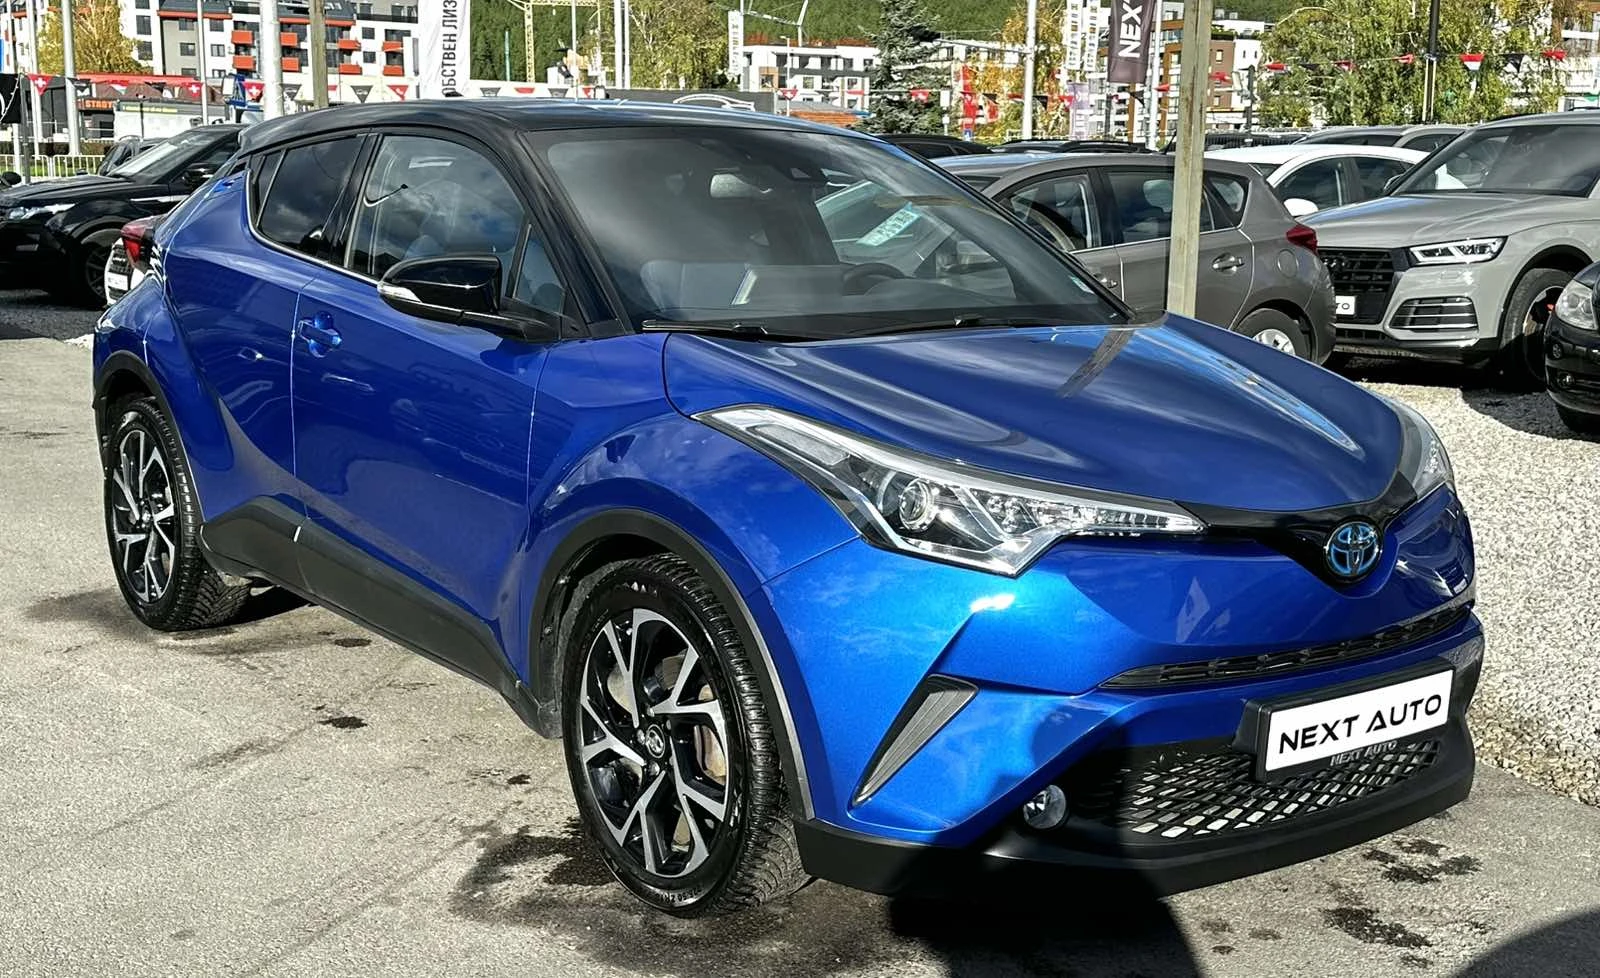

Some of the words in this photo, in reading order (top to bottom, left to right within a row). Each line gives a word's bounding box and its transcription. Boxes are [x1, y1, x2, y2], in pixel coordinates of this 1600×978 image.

[1118, 0, 1143, 58] NEX
[1279, 714, 1360, 754] NEXT
[1365, 694, 1442, 733] AUTO
[1329, 748, 1364, 767] NEXT
[1364, 740, 1398, 759] AUTO
